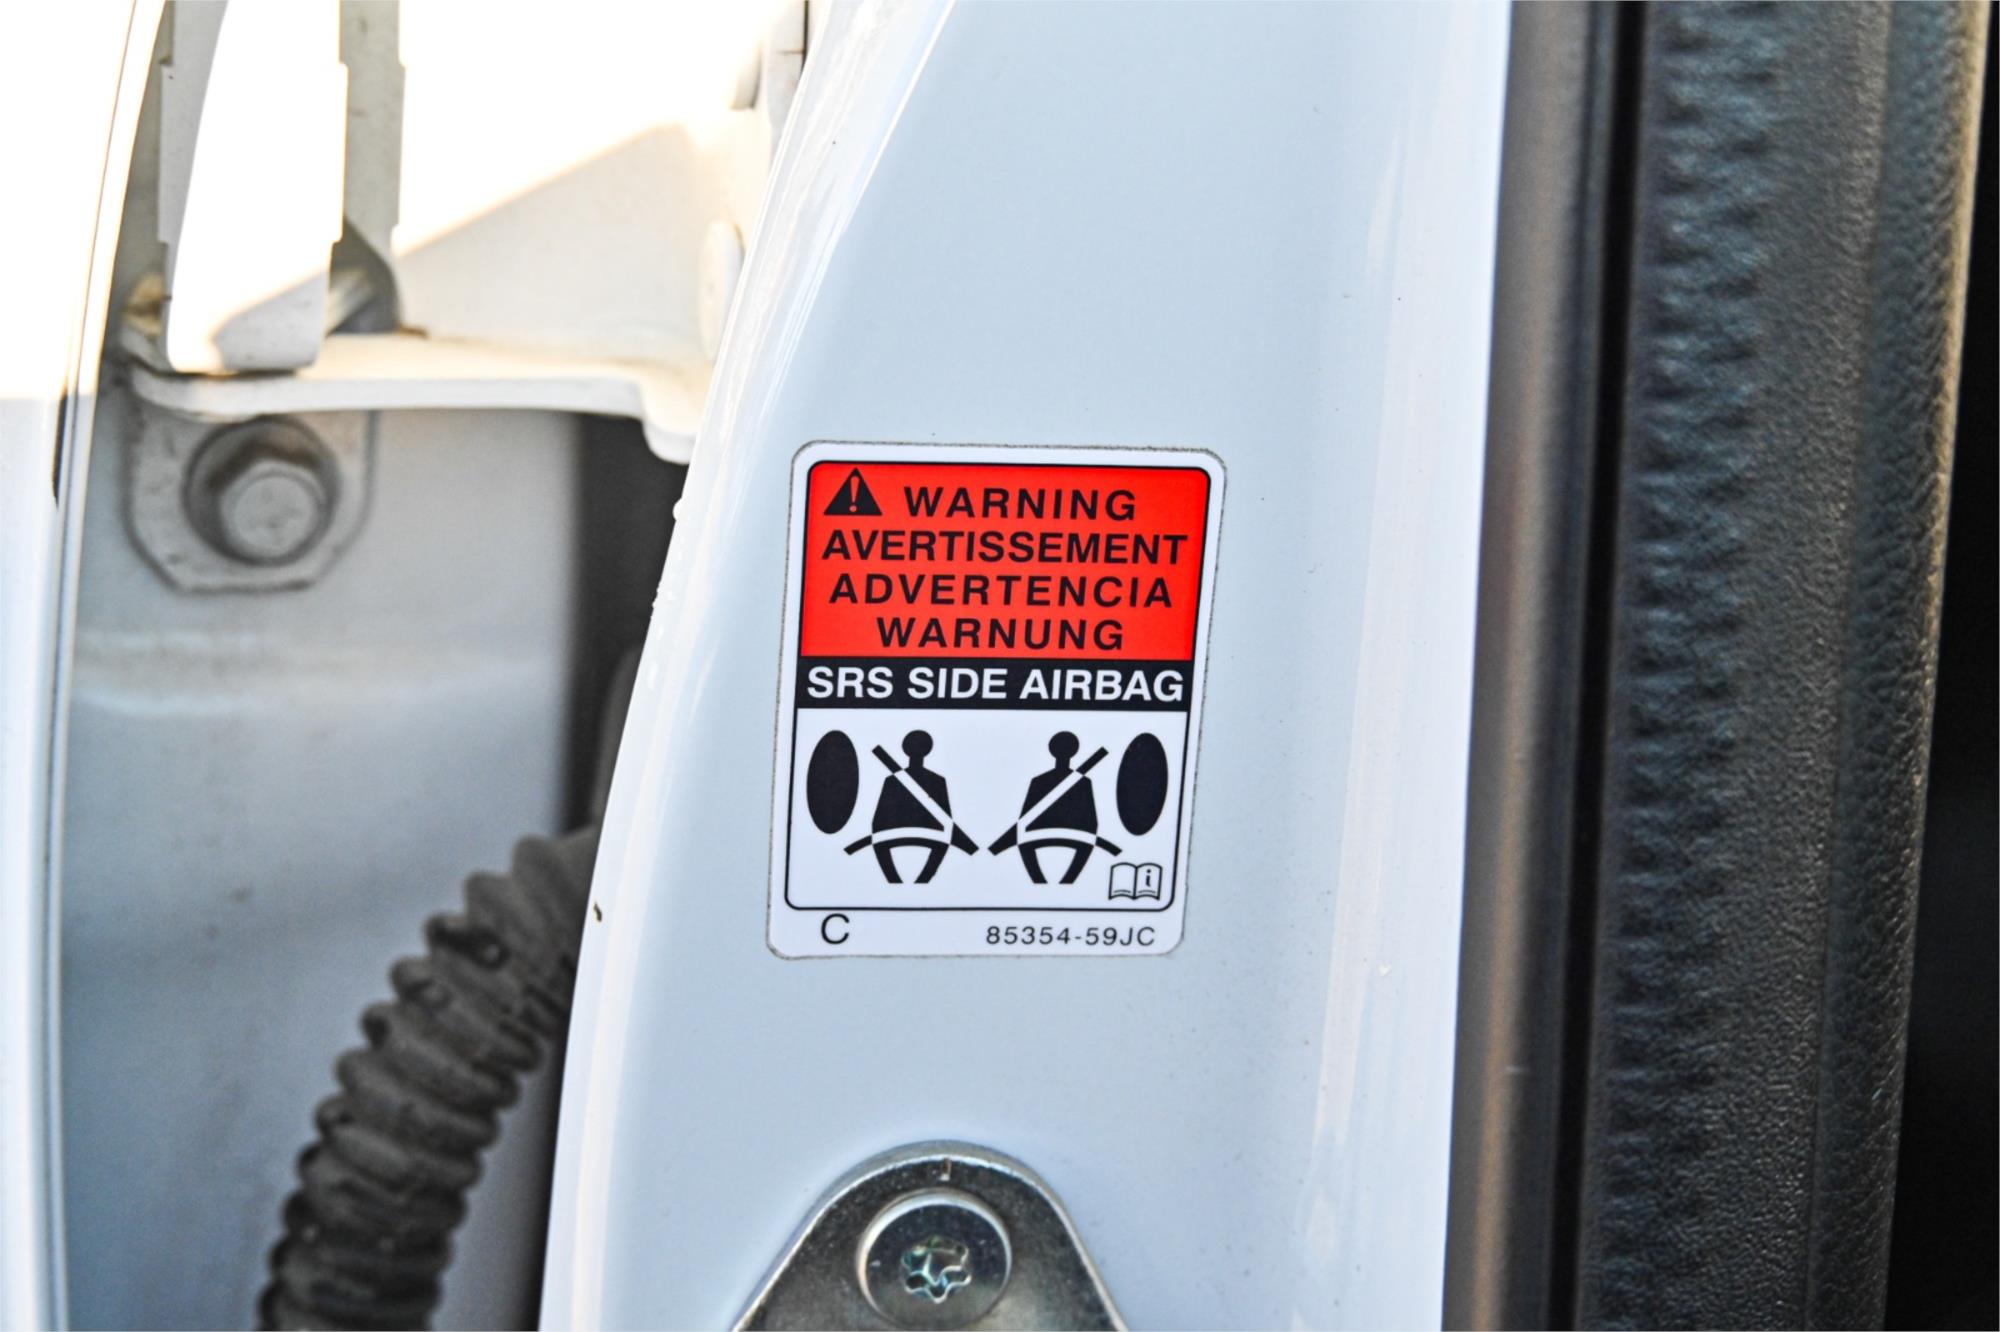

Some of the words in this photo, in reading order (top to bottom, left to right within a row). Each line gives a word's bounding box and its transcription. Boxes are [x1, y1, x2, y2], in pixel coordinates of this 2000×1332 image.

[904, 486, 1135, 521] WARNING
[822, 529, 1188, 565] AVERTISSEMENT
[830, 573, 1172, 608] ADVERTENCIA
[877, 617, 1123, 651] WARNUNG
[807, 666, 893, 699] SRS
[907, 666, 1008, 699] SIDE
[1019, 669, 1183, 702] AIRBAG
[820, 912, 850, 945] C
[986, 925, 1155, 946] 85354-59JC
